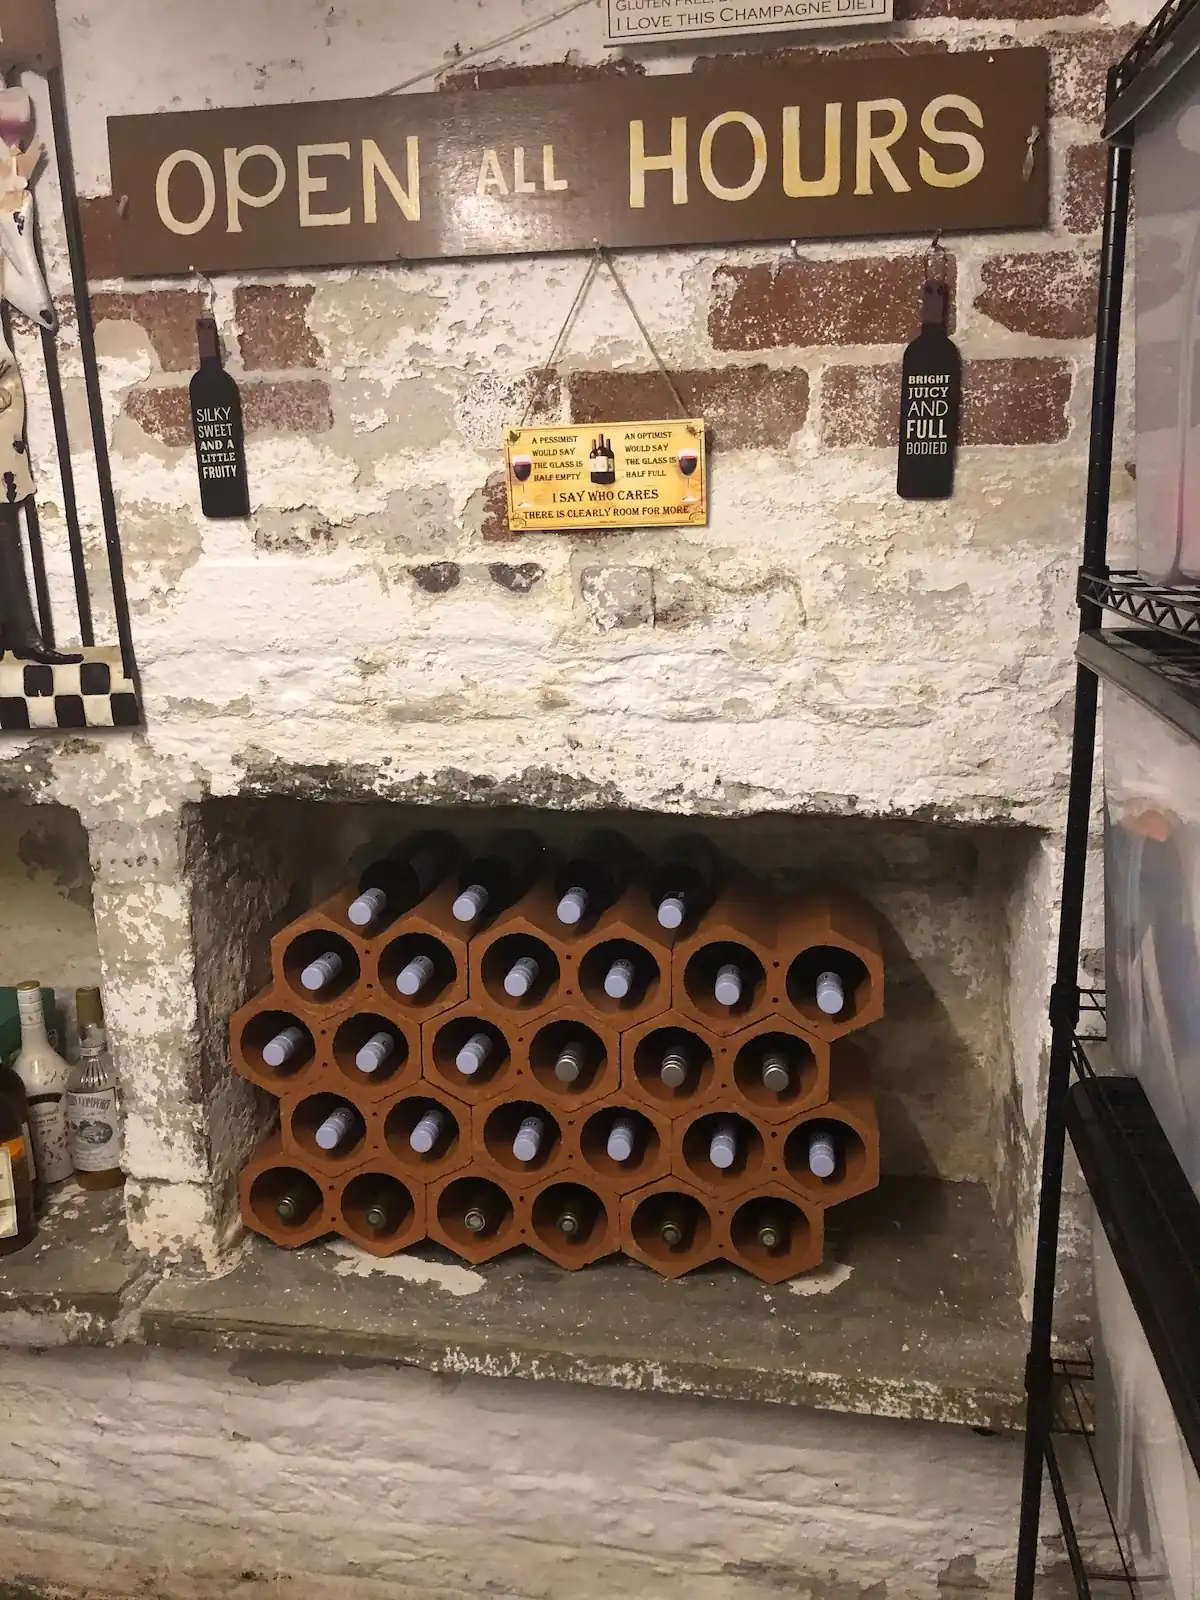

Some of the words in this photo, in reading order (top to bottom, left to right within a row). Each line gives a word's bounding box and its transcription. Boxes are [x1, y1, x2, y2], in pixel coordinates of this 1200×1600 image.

[616, 0, 670, 11] GLUTEN
[617, 18, 620, 31] I
[626, 15, 673, 30] LOVE
[677, 12, 715, 26] THIS
[719, 1, 832, 22] CHAMPAGNE
[837, 0, 876, 12] DIET
[155, 135, 421, 236] OPEN
[475, 144, 568, 197] ALL
[628, 93, 985, 209] HOURS
[908, 374, 951, 385] BRIGHT
[908, 386, 949, 400] JUICY
[196, 406, 232, 423] SILKY
[907, 400, 949, 417] AND
[197, 423, 233, 439] SWEET
[624, 432, 636, 440] AN
[637, 431, 673, 440] OPTIMIST
[906, 419, 948, 440] FULL
[200, 439, 223, 451] AND
[226, 439, 235, 449] A
[532, 437, 538, 445] A
[540, 435, 578, 444] PESSIMIST
[532, 449, 558, 457] WOULD
[559, 447, 576, 456] SAY
[625, 444, 651, 453] WOULD
[652, 443, 669, 452] SAY
[905, 441, 948, 456] BODIED
[201, 452, 236, 464] LITTLE
[625, 458, 640, 466] THE
[642, 457, 668, 465] GLASS
[669, 456, 677, 464] IS
[549, 461, 575, 469] GLASS
[576, 460, 584, 468] IS
[202, 464, 237, 480] FRUITY
[534, 474, 554, 482] HALF
[555, 472, 581, 481] EMPTY
[648, 470, 667, 478] FULL
[552, 493, 556, 504] I
[559, 490, 586, 503] SAY
[588, 490, 614, 502] WHO
[617, 489, 659, 501] CARES
[523, 510, 554, 520] THERE
[556, 509, 565, 518] IS
[567, 507, 611, 518] CLEARLY
[613, 507, 639, 517] ROOM
[642, 506, 660, 515] FOR
[662, 505, 689, 515] MORE
